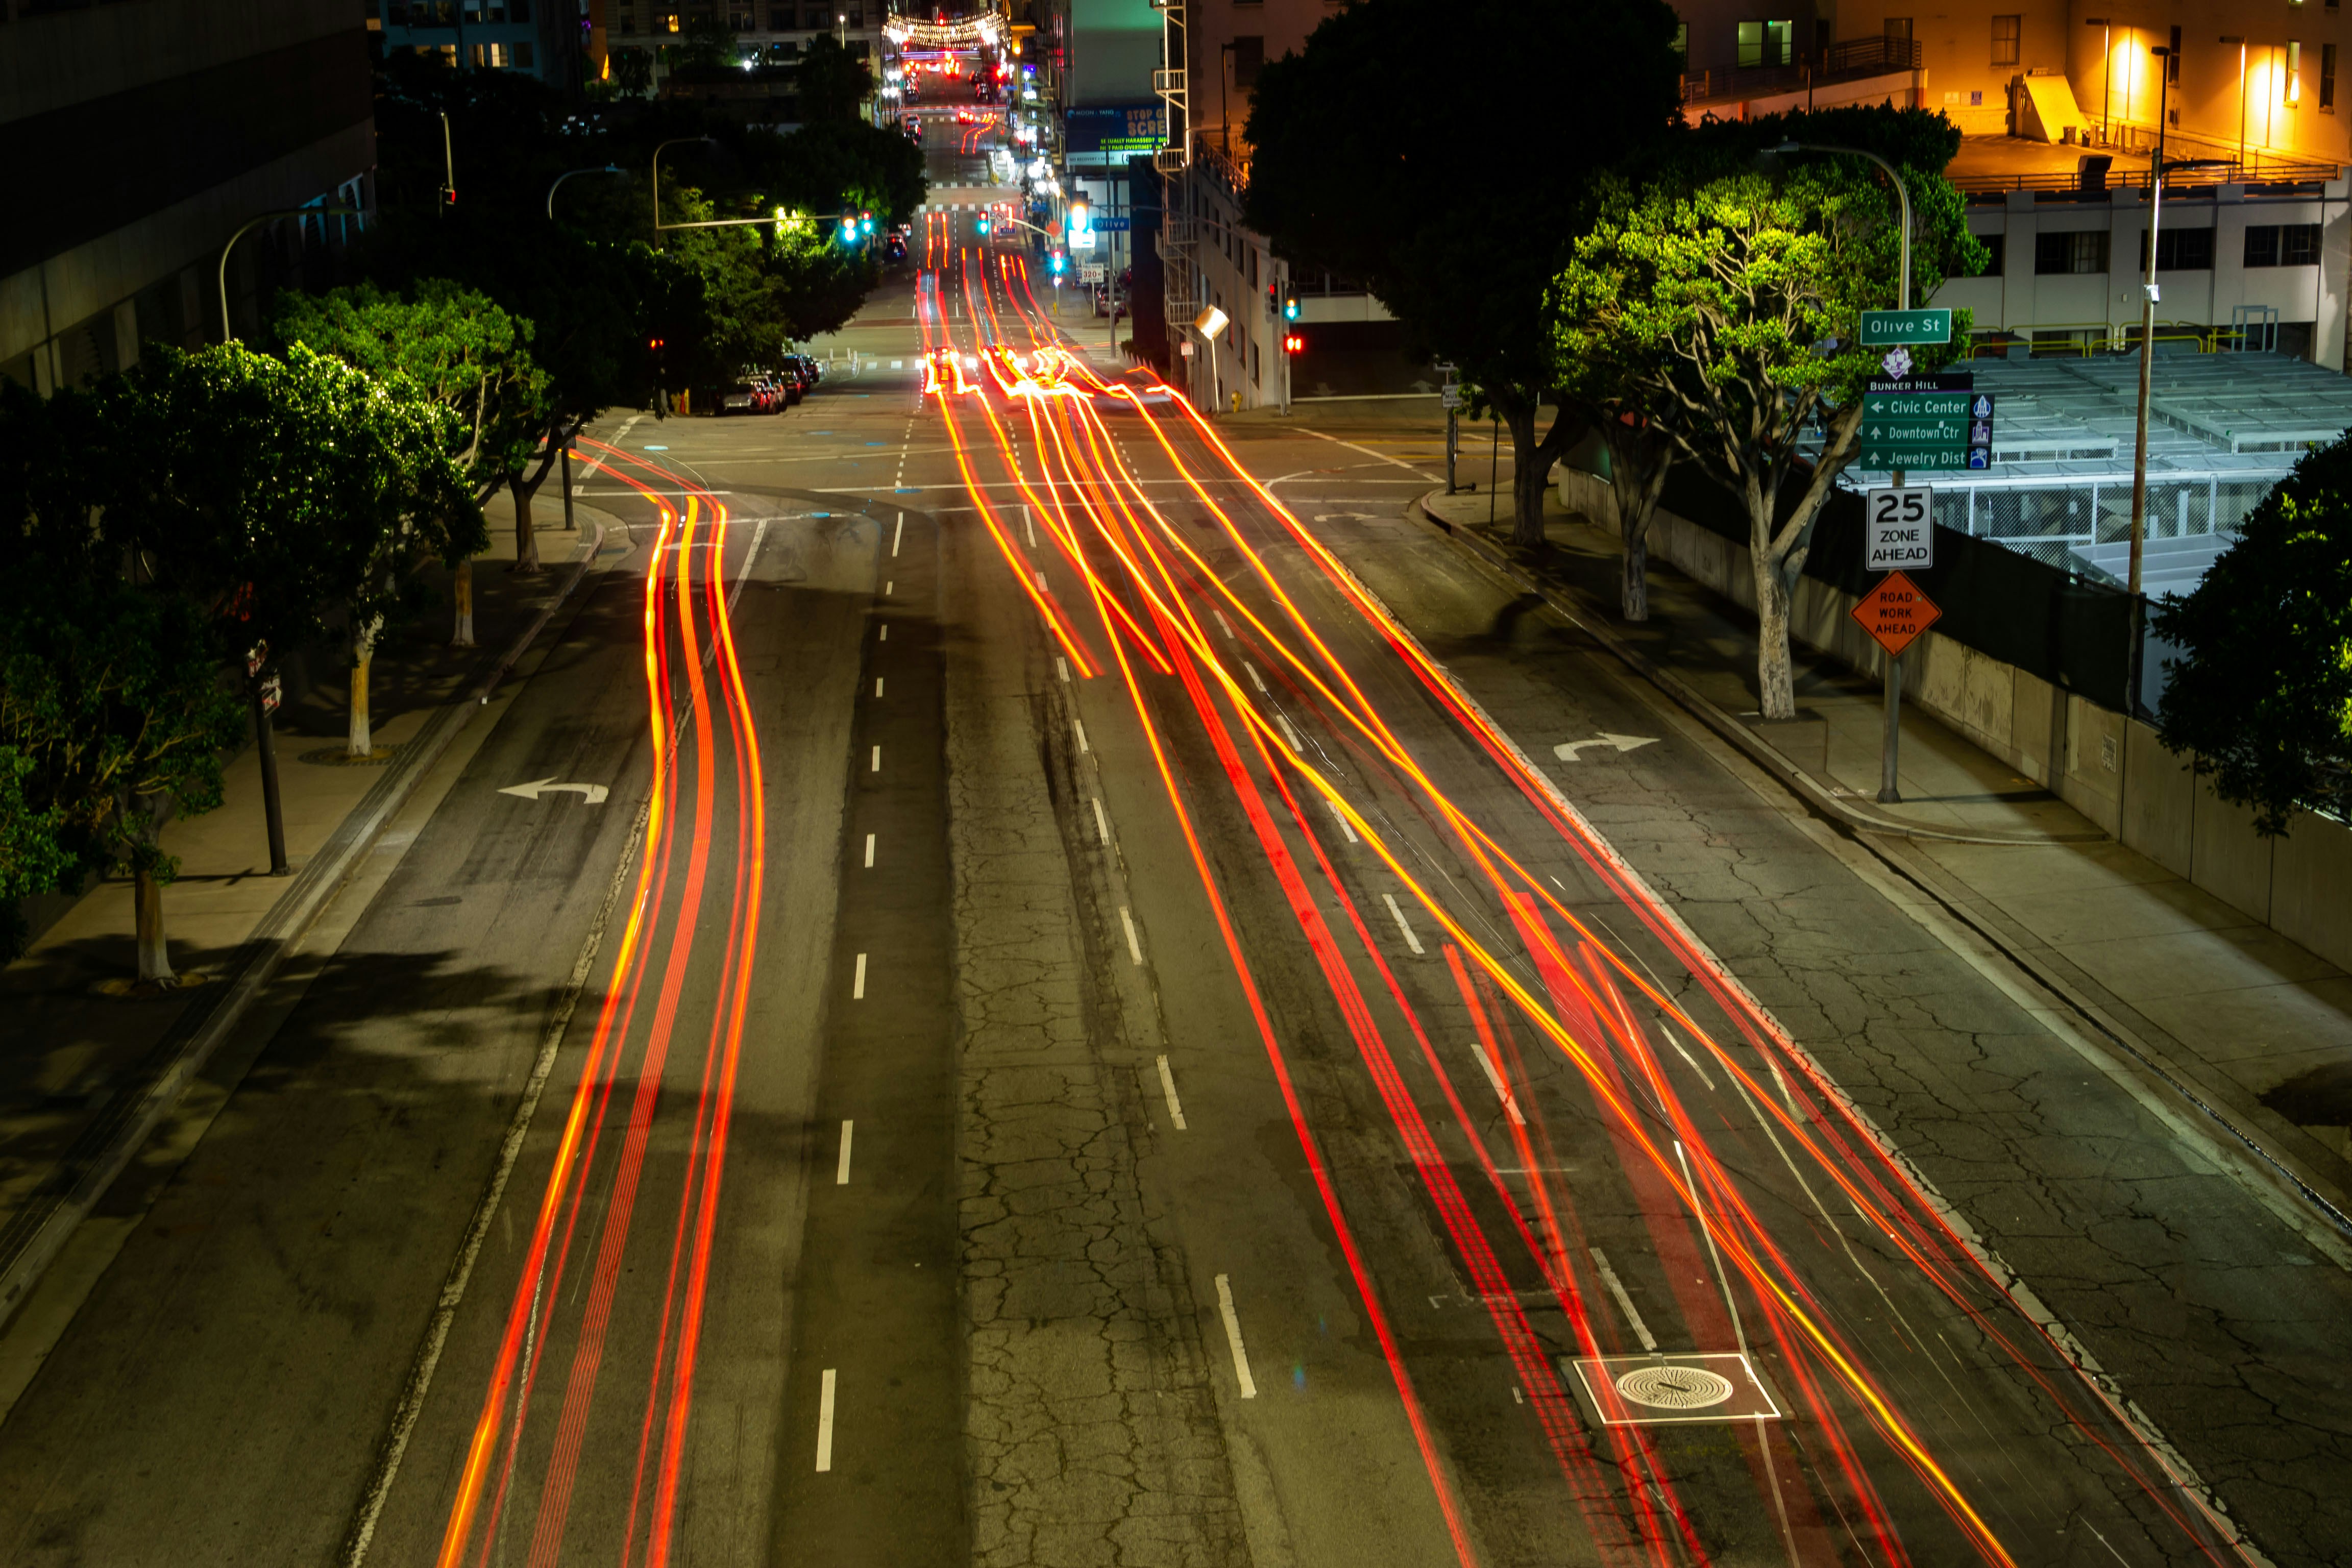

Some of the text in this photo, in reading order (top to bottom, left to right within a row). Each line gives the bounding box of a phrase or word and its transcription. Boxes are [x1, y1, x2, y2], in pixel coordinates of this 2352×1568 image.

[1127, 109, 1152, 119] STOP
[1871, 318, 1940, 333] Olive St
[1870, 380, 1938, 391] BUNKER HILL
[1891, 400, 1966, 414] Civic Center
[1889, 426, 1959, 439] Downtown Ctr
[1888, 451, 1965, 467] Jewelry Dist
[1876, 493, 1924, 523] 25
[1880, 529, 1919, 543] ZONE
[1872, 548, 1927, 561] AHEAD
[1880, 592, 1912, 602] ROAD
[1879, 608, 1912, 618] WORK
[1875, 624, 1916, 634] AHEAD
